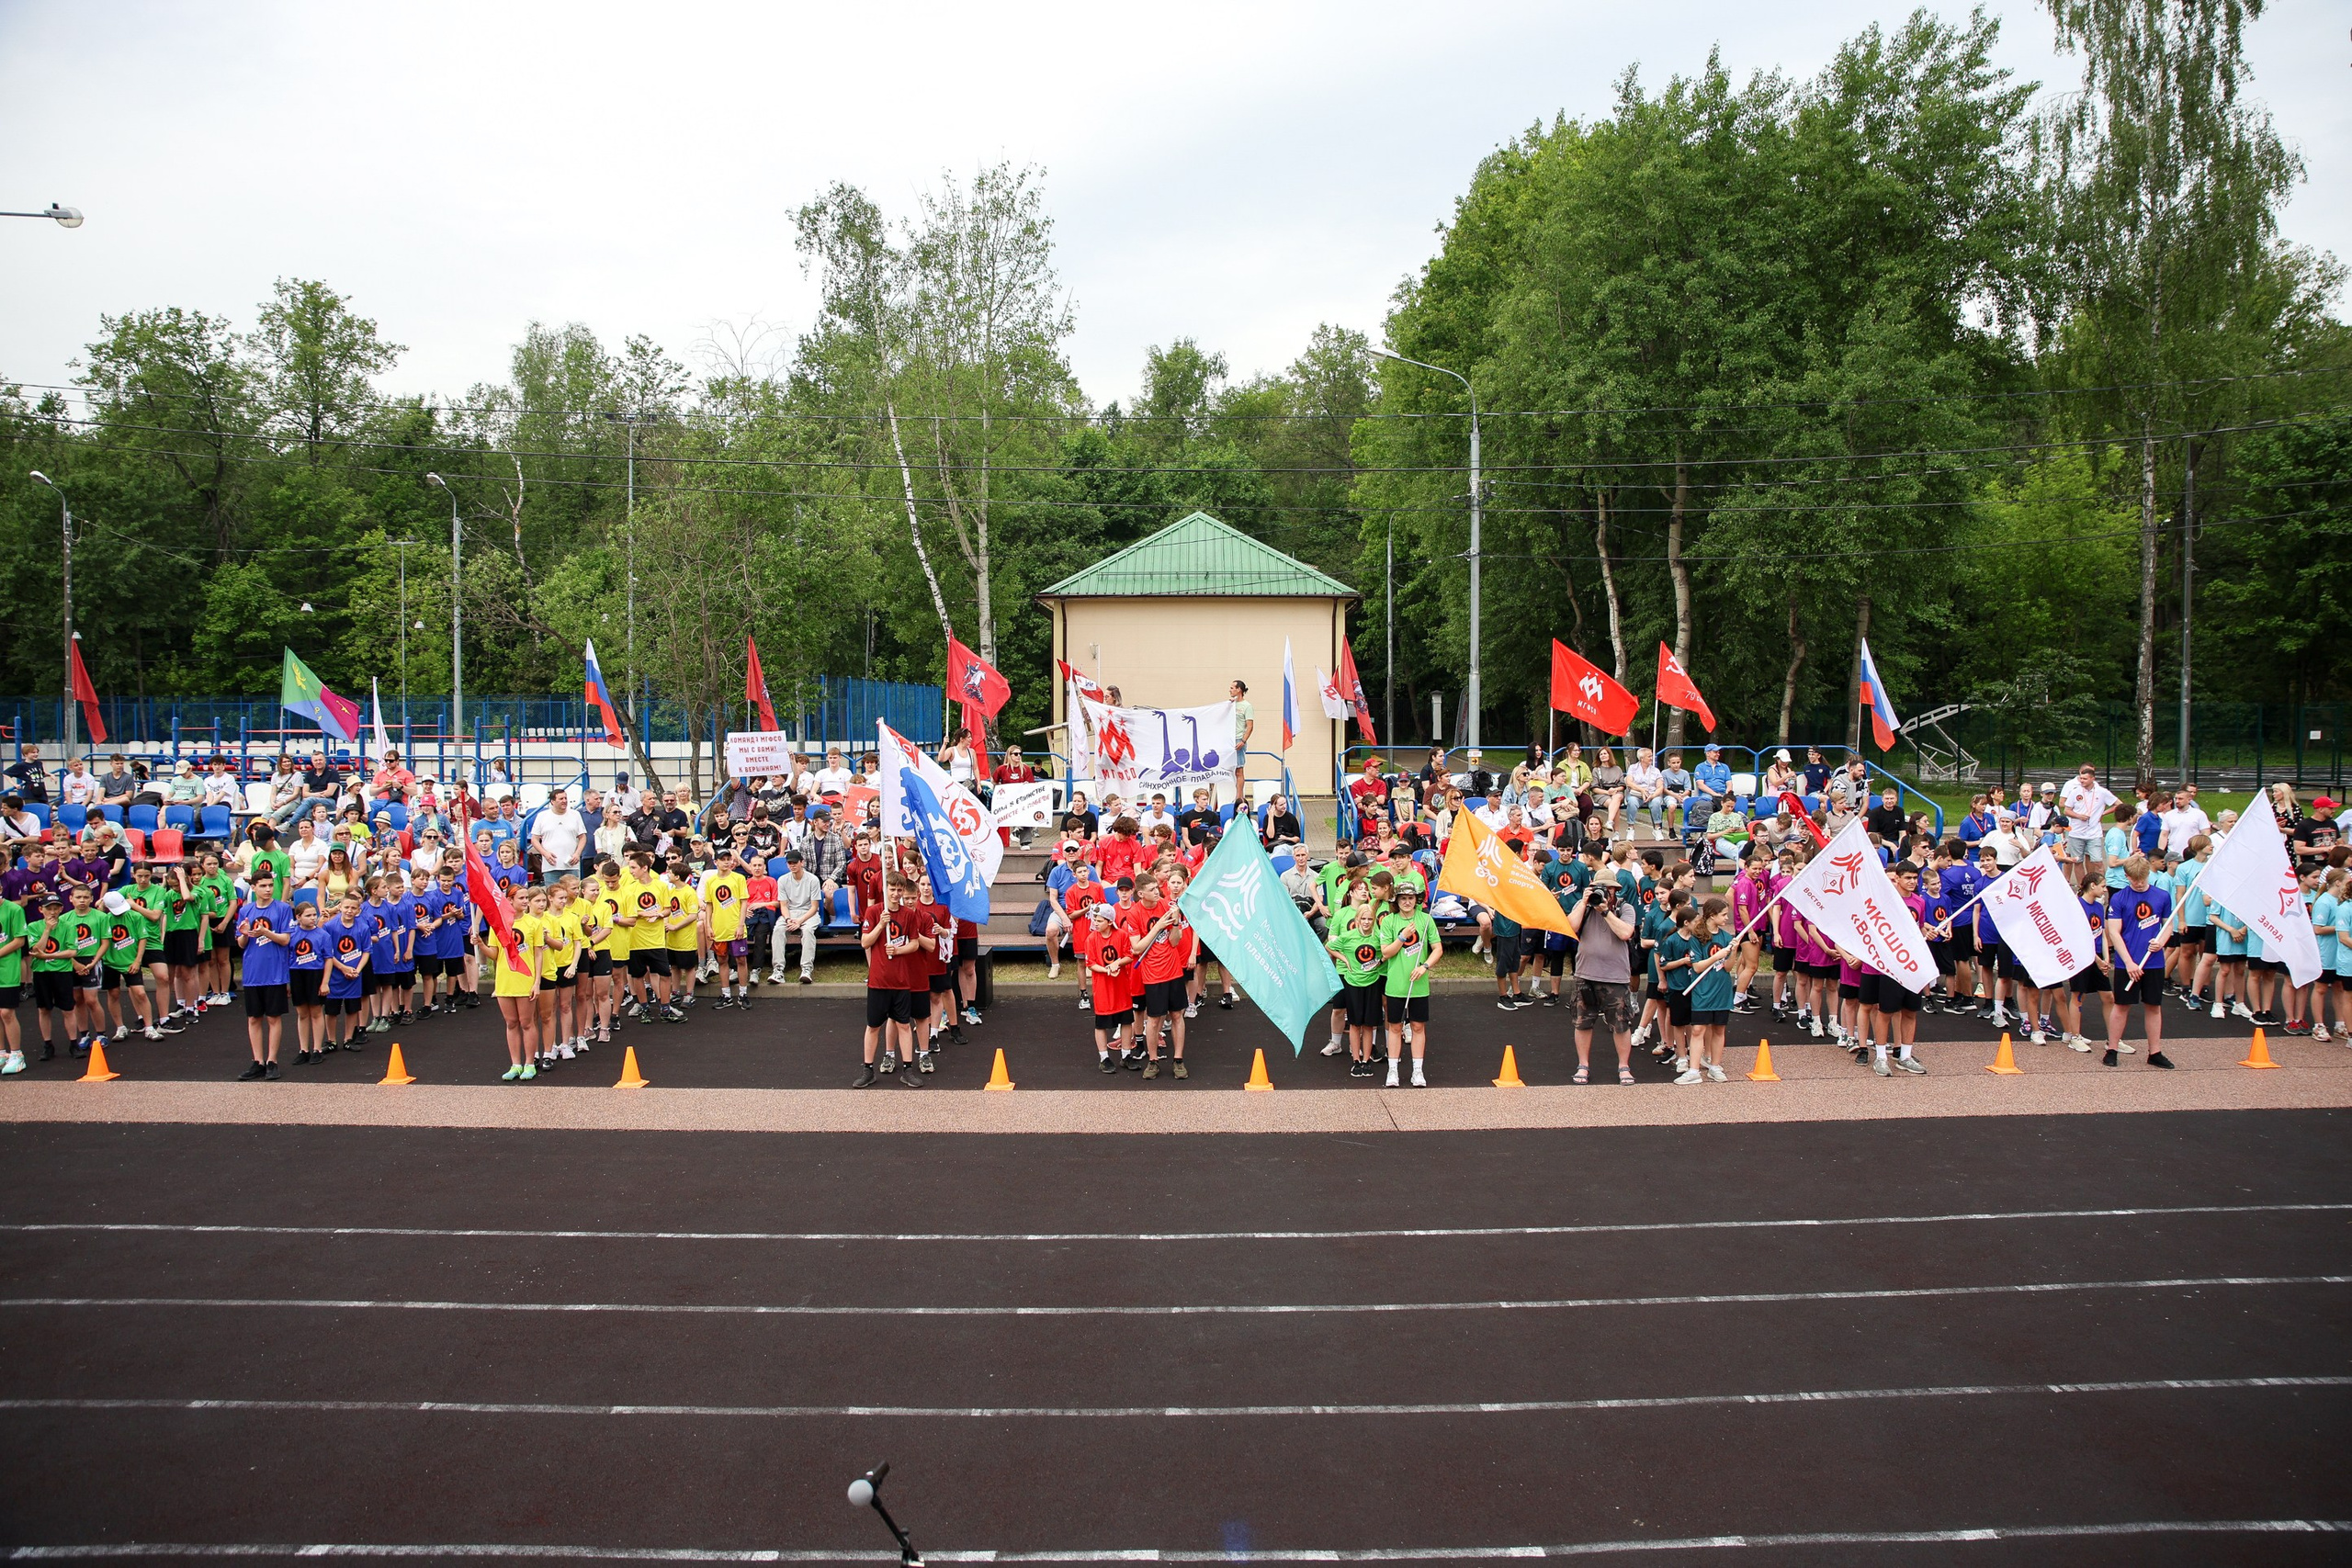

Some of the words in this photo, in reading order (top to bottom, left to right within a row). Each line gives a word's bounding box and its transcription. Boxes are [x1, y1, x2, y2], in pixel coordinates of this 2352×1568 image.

[1139, 775, 1187, 790] СИНХРОННОЕ
[1509, 878, 1534, 889] спорта
[1829, 879, 1837, 887] В
[1864, 897, 1919, 973] МКСШОР
[2026, 900, 2063, 946] МКСШОР
[2257, 914, 2284, 943] Запад
[1244, 941, 1285, 988] плавания
